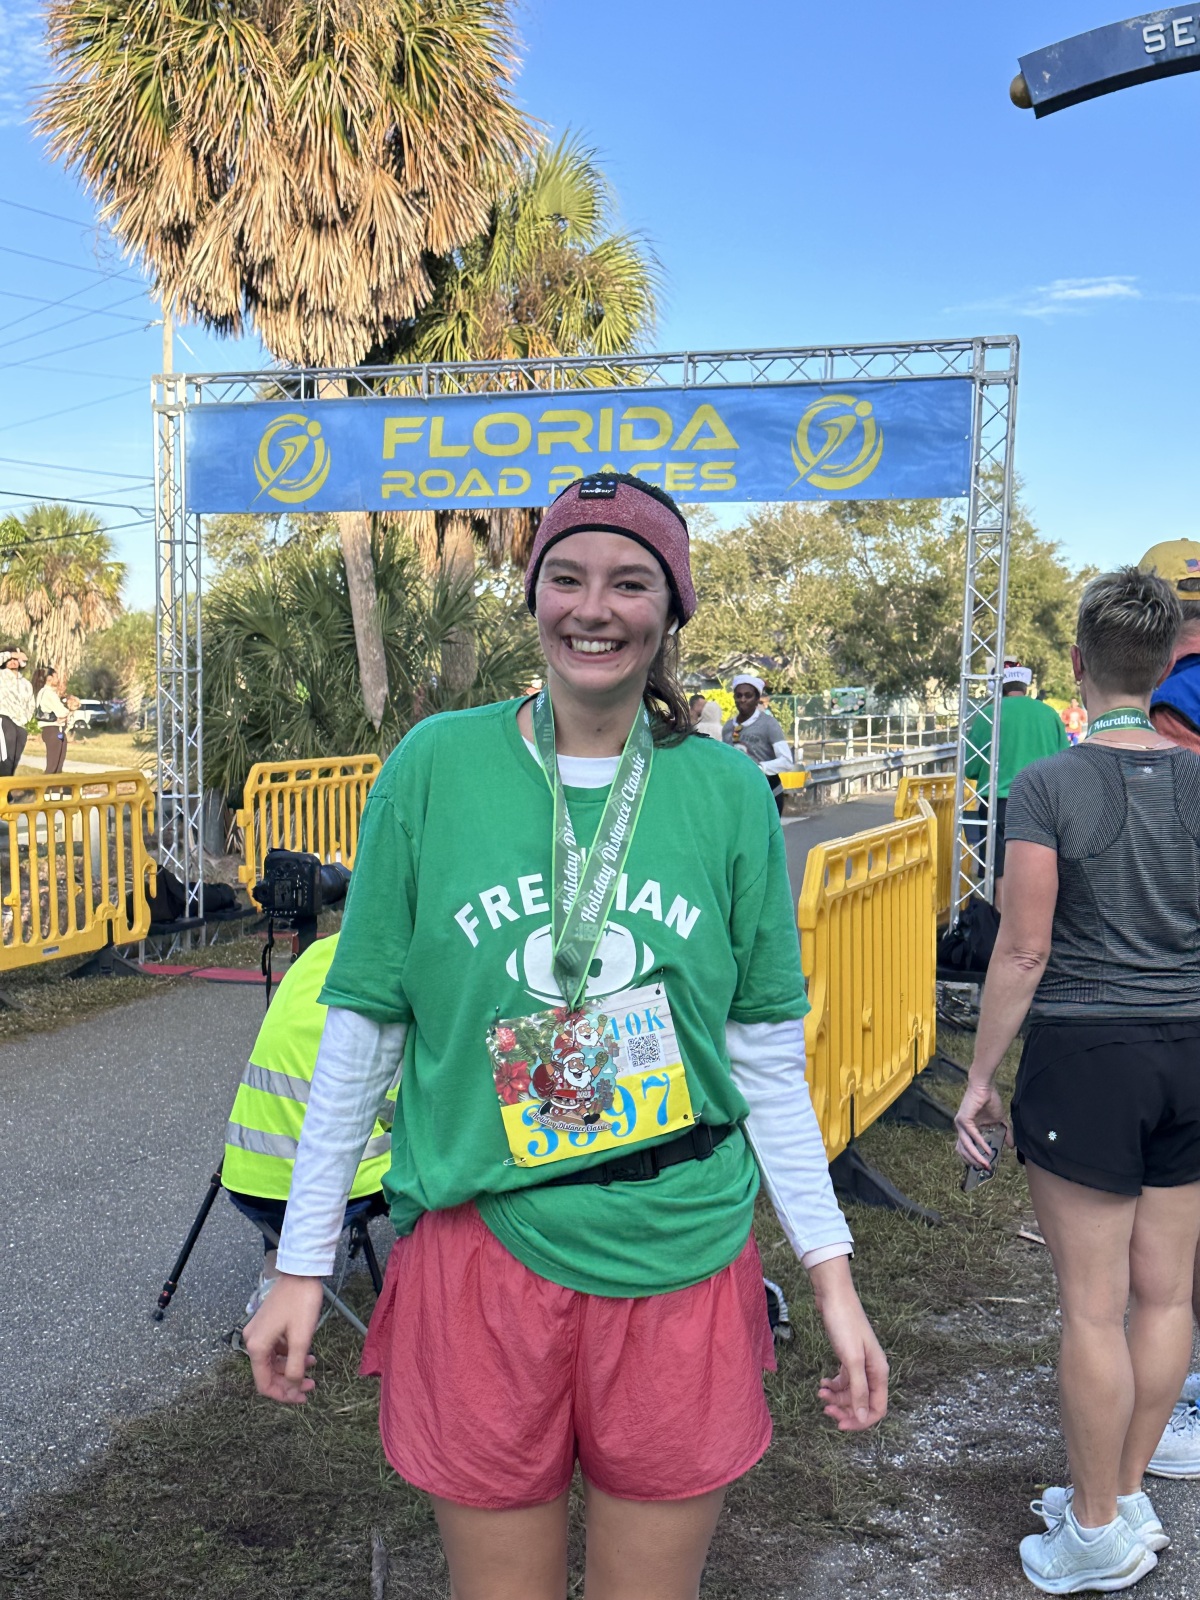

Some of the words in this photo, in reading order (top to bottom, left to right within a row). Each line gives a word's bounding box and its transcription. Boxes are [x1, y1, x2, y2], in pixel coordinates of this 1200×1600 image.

[1142, 15, 1200, 54] SE
[383, 403, 740, 459] FLORIDA
[381, 467, 532, 499] ROAD
[1094, 714, 1141, 730] Marathon
[581, 863, 617, 923] Holiday
[601, 801, 632, 863] Distance
[620, 753, 646, 802] Classic
[453, 873, 702, 949] FREAN
[610, 1005, 667, 1041] 10K
[558, 1122, 585, 1132] Distance
